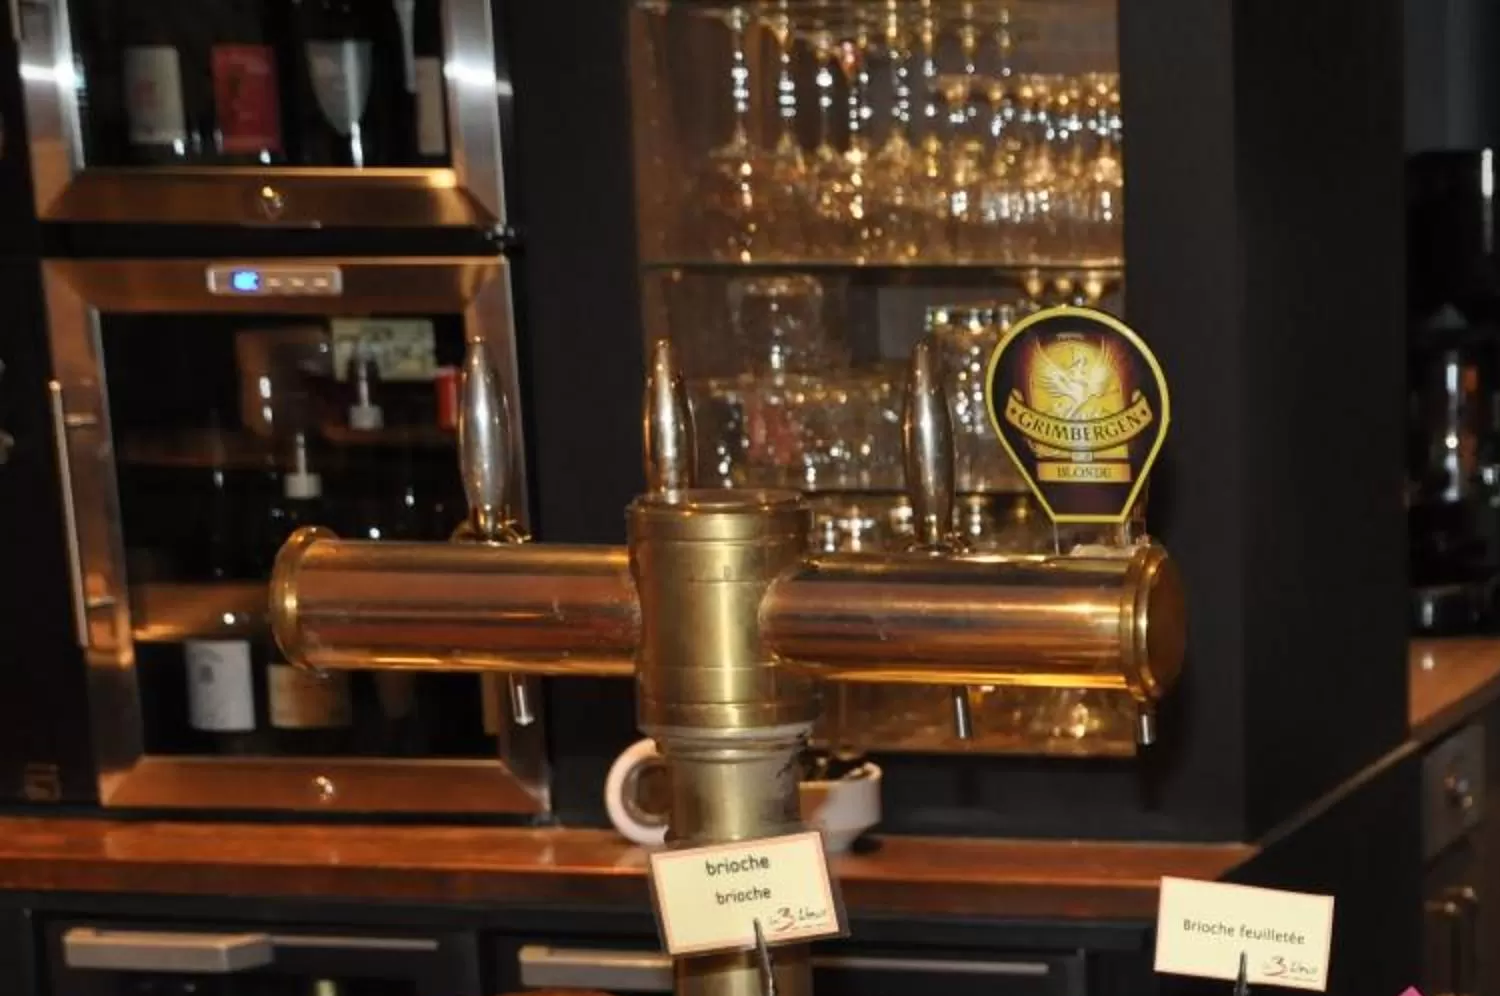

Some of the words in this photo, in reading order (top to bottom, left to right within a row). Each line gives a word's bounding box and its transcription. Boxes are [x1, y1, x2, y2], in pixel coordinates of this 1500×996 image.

[1018, 410, 1142, 442] GRIMBERGEN
[1057, 466, 1112, 479] BLONDE
[705, 854, 770, 876] brioche
[715, 885, 772, 905] brioche
[1183, 917, 1235, 937] Brioche
[1239, 923, 1306, 946] feuilletée
